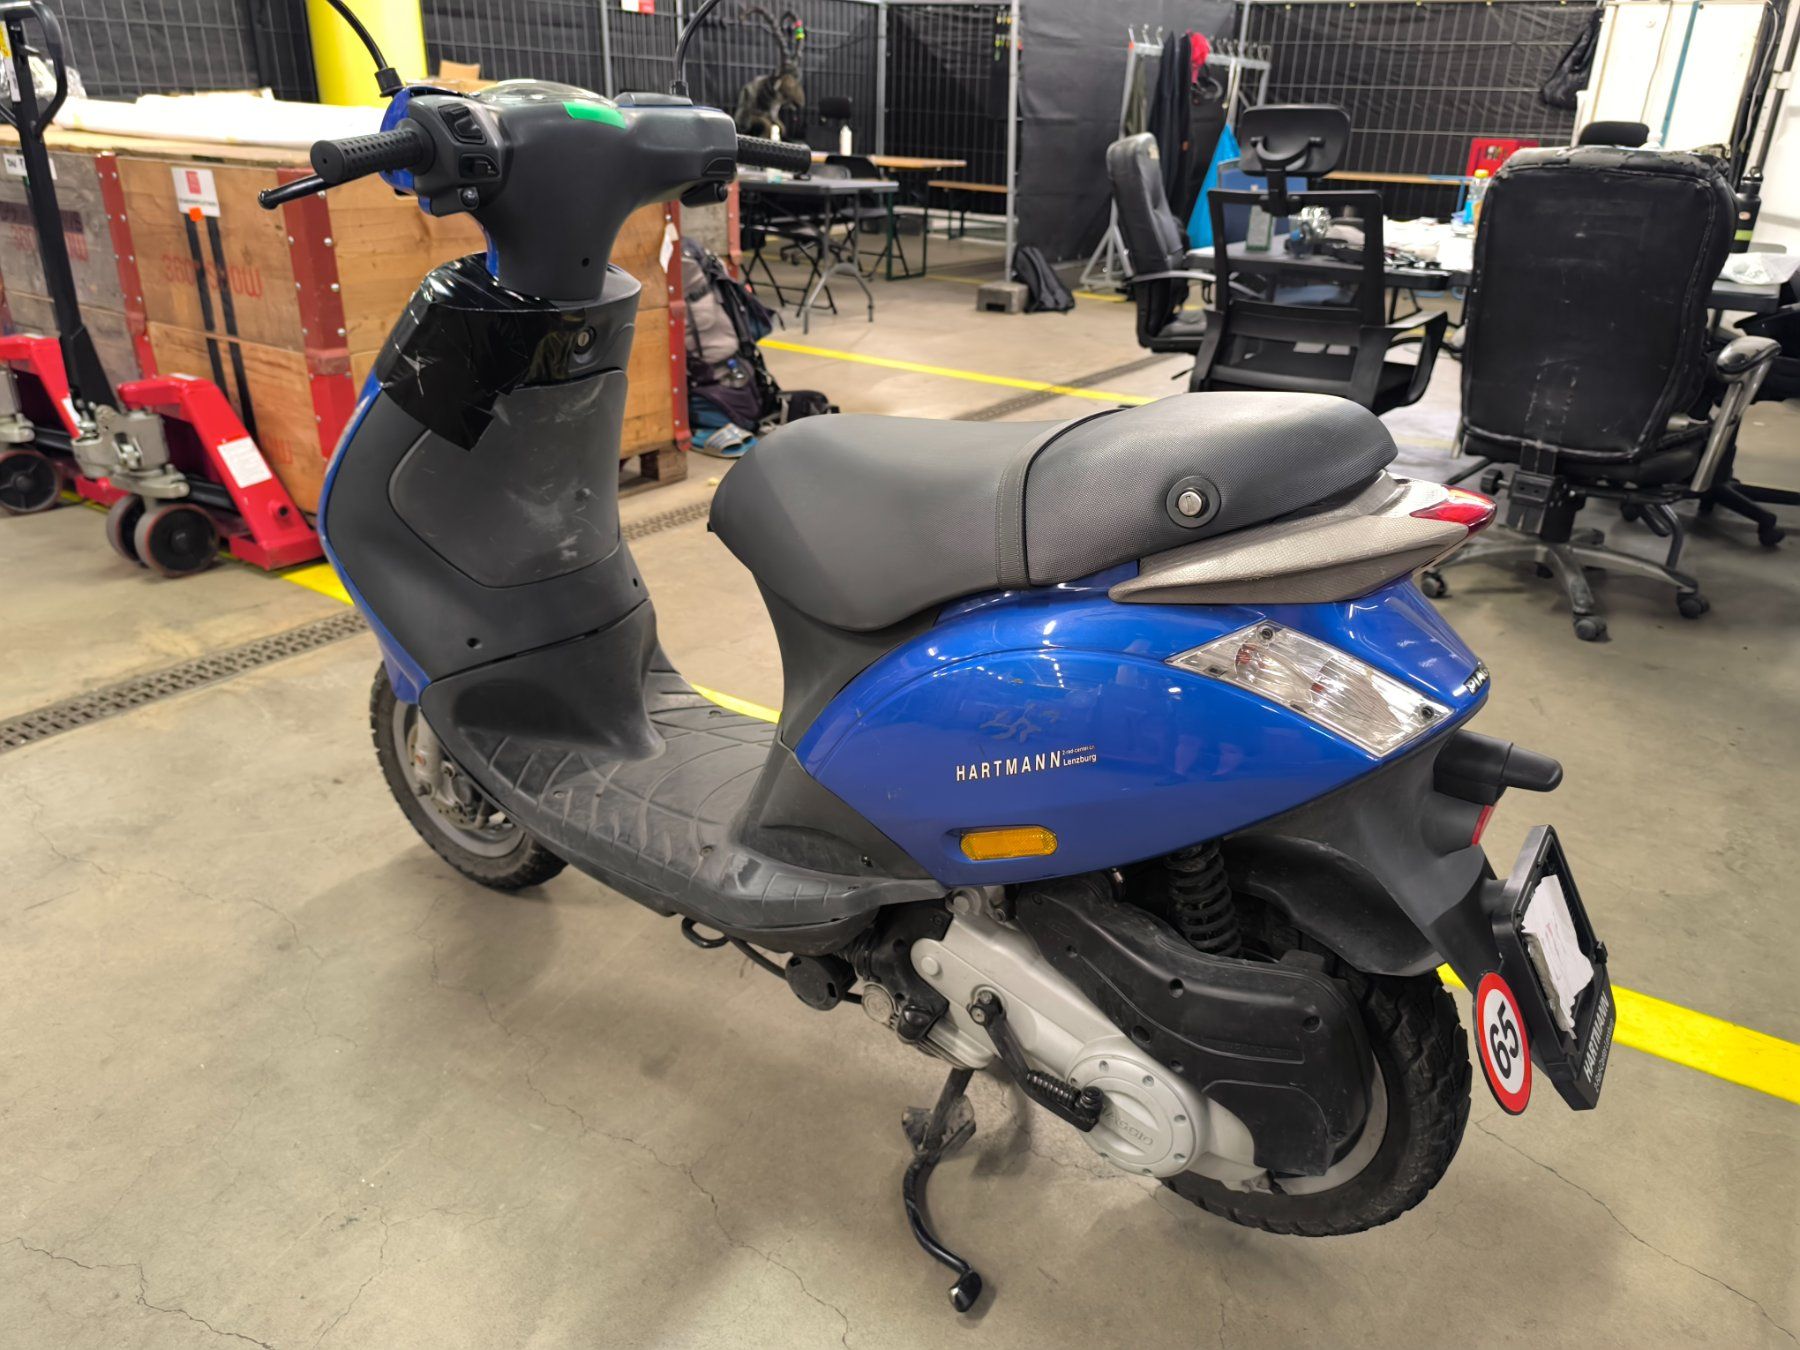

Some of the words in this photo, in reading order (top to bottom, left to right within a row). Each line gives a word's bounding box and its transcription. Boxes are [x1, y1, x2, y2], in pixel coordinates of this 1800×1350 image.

[956, 751, 1061, 781] HARTMANN
[1063, 754, 1097, 766] Lenzburg
[1489, 1000, 1519, 1079] 65
[1583, 990, 1610, 1084] HARTMANN
